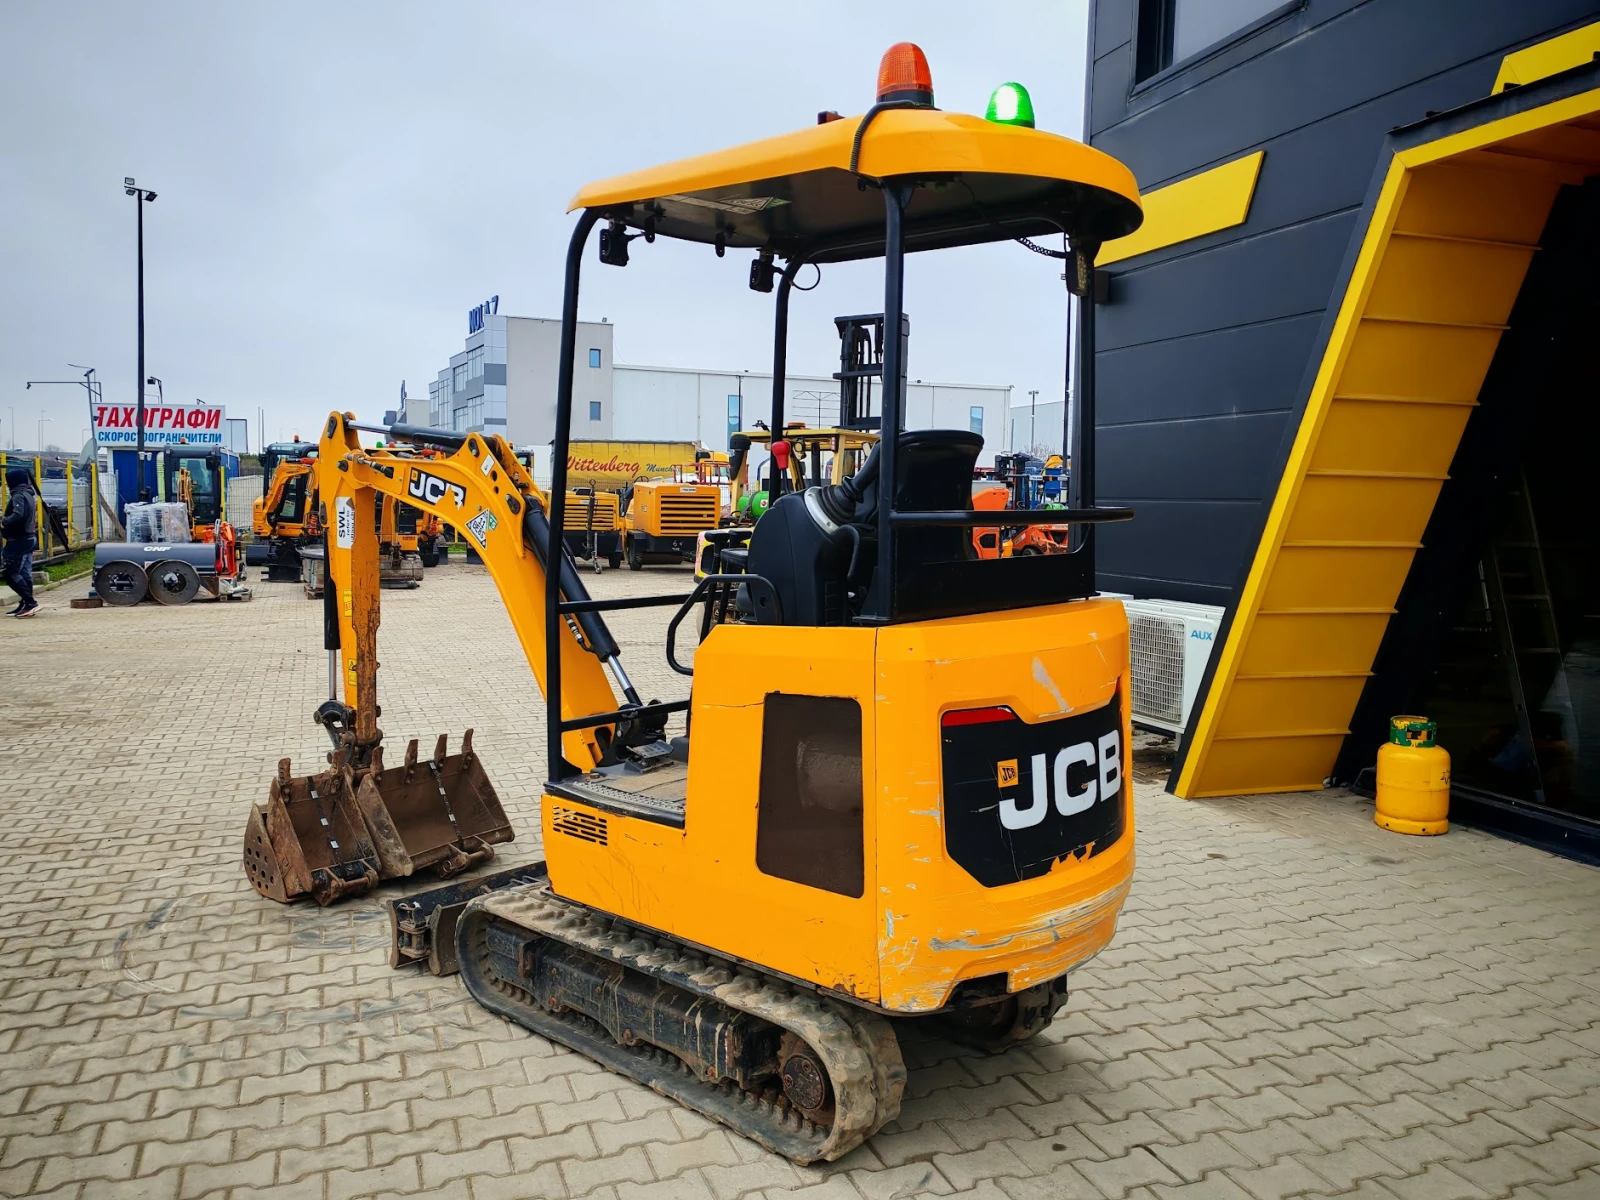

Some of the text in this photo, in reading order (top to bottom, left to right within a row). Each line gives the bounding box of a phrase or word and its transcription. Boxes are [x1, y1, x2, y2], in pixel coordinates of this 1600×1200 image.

[98, 431, 222, 443] СКОРОСООГРАНИЧИТЕЛИ
[1191, 630, 1212, 641] AUX
[999, 730, 1121, 830] JCB
[1002, 767, 1016, 781] JCB
